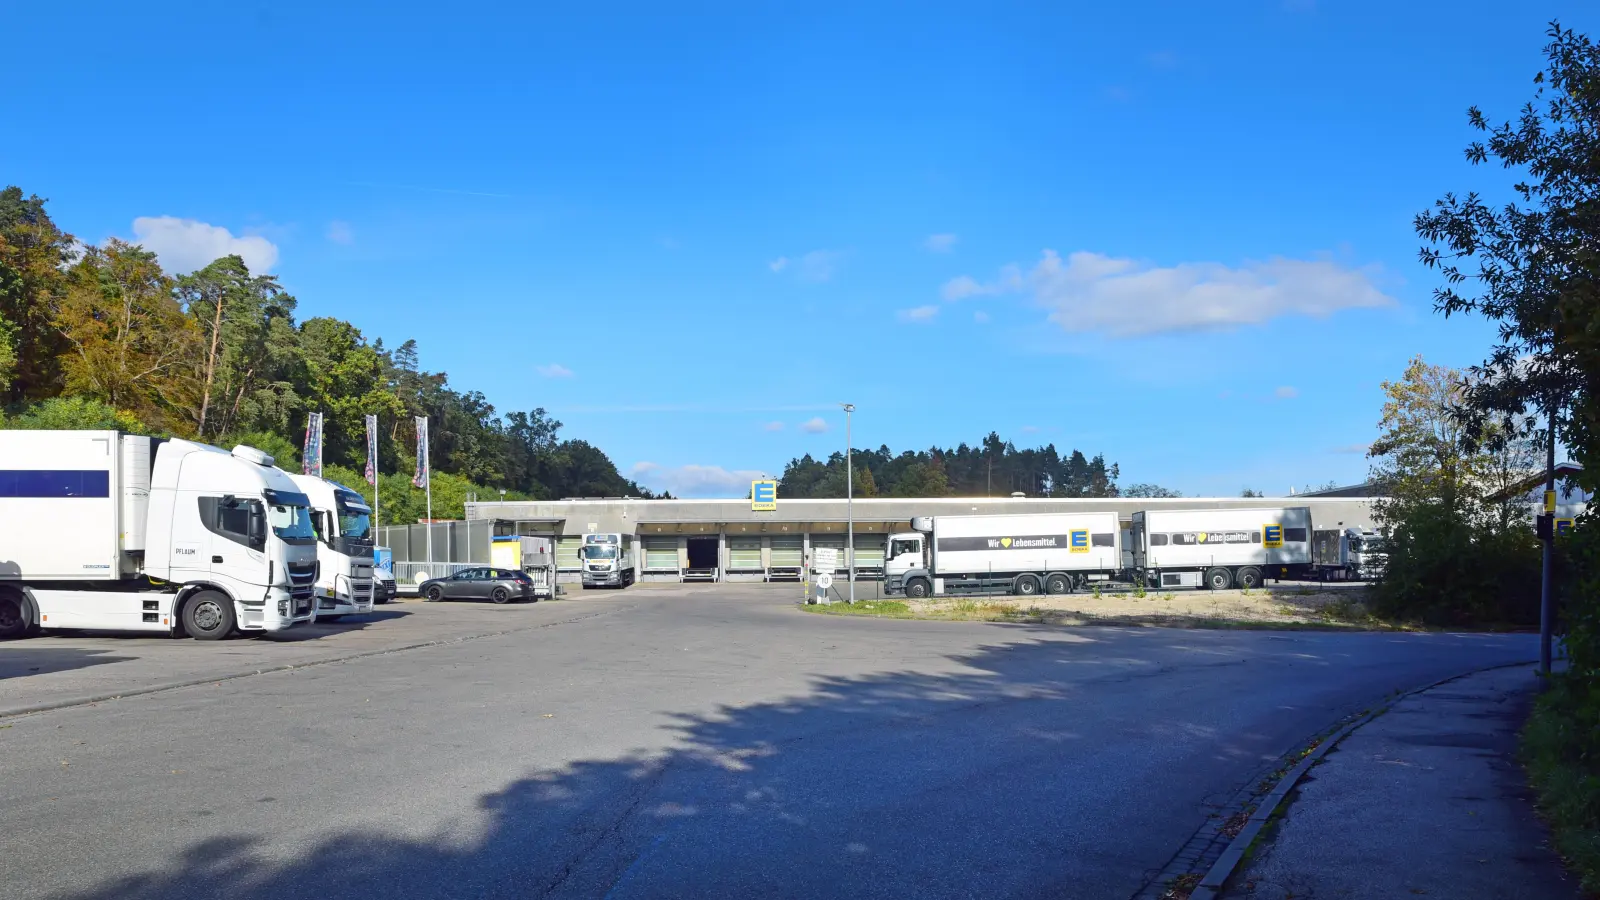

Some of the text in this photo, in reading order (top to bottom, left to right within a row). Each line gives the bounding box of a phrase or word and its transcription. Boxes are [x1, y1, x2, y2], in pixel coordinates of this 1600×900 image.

[755, 484, 773, 502] E
[1072, 532, 1087, 547] E
[1183, 534, 1195, 543] Wir
[1265, 526, 1280, 541] E
[988, 538, 1057, 548] Wir Lebensmittel.
